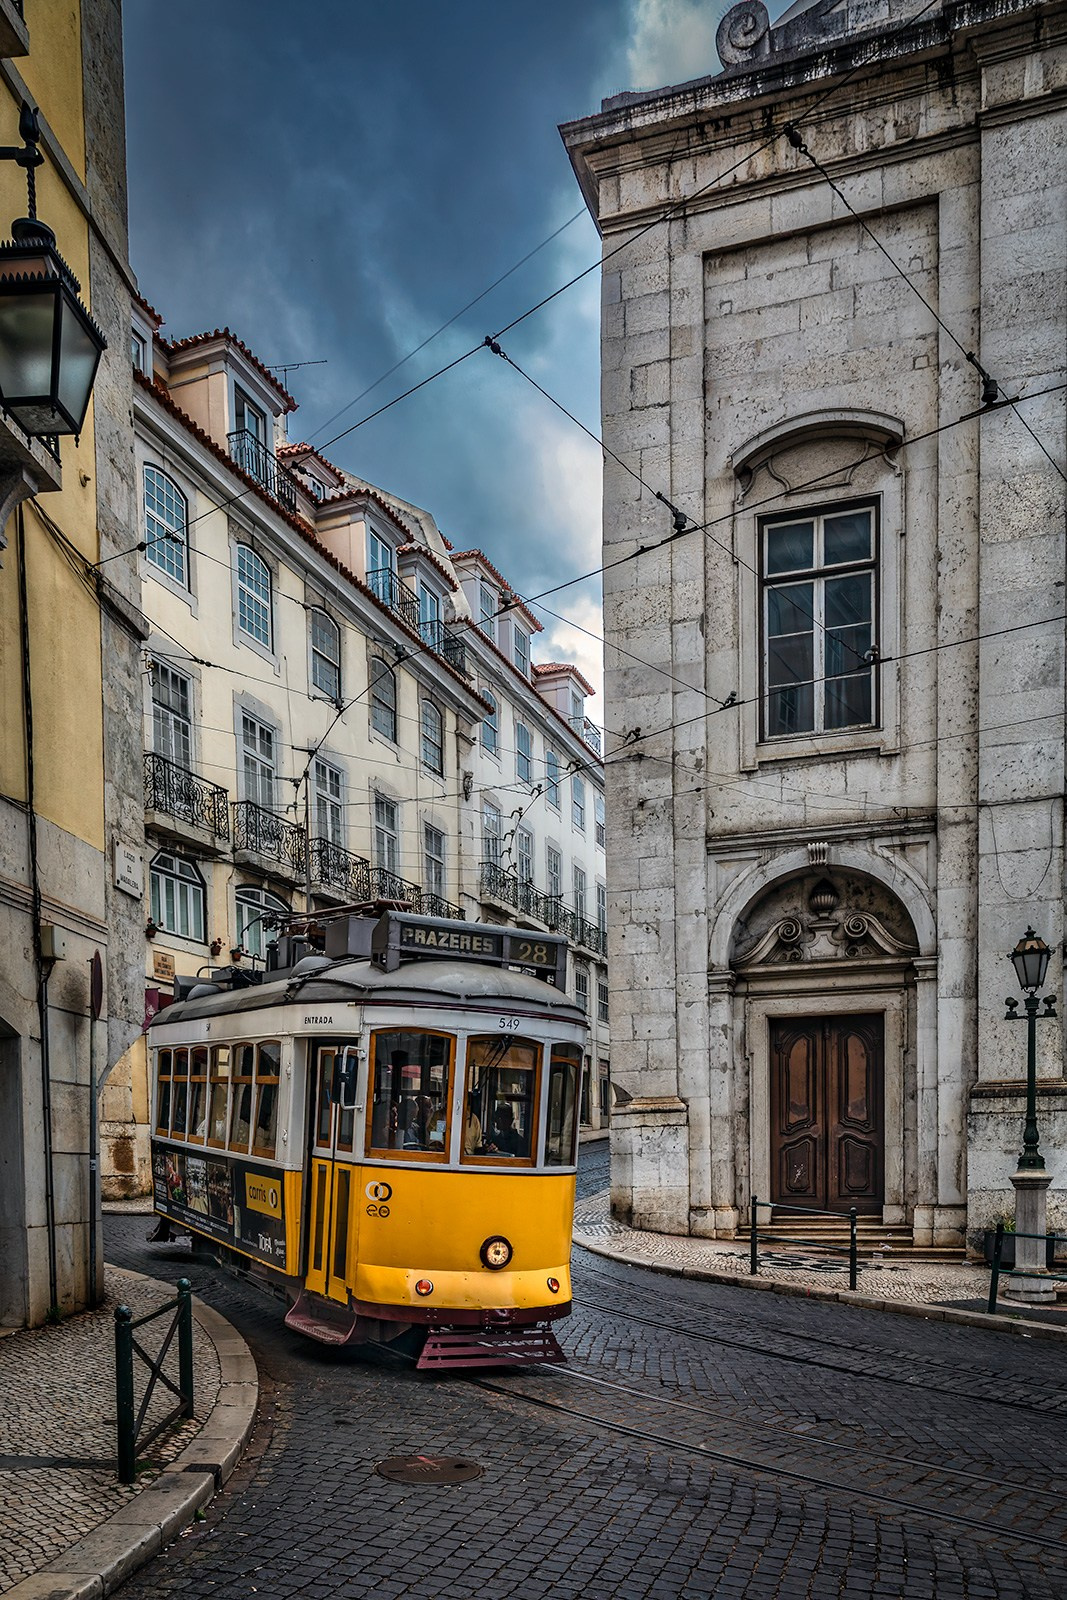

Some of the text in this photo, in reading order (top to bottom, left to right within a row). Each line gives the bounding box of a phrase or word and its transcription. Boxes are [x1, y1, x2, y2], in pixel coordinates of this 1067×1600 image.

[402, 927, 547, 964] PRAZERES 28
[304, 1016, 333, 1025] ENTRADA
[498, 1017, 519, 1031] 549
[248, 1184, 267, 1203] carris
